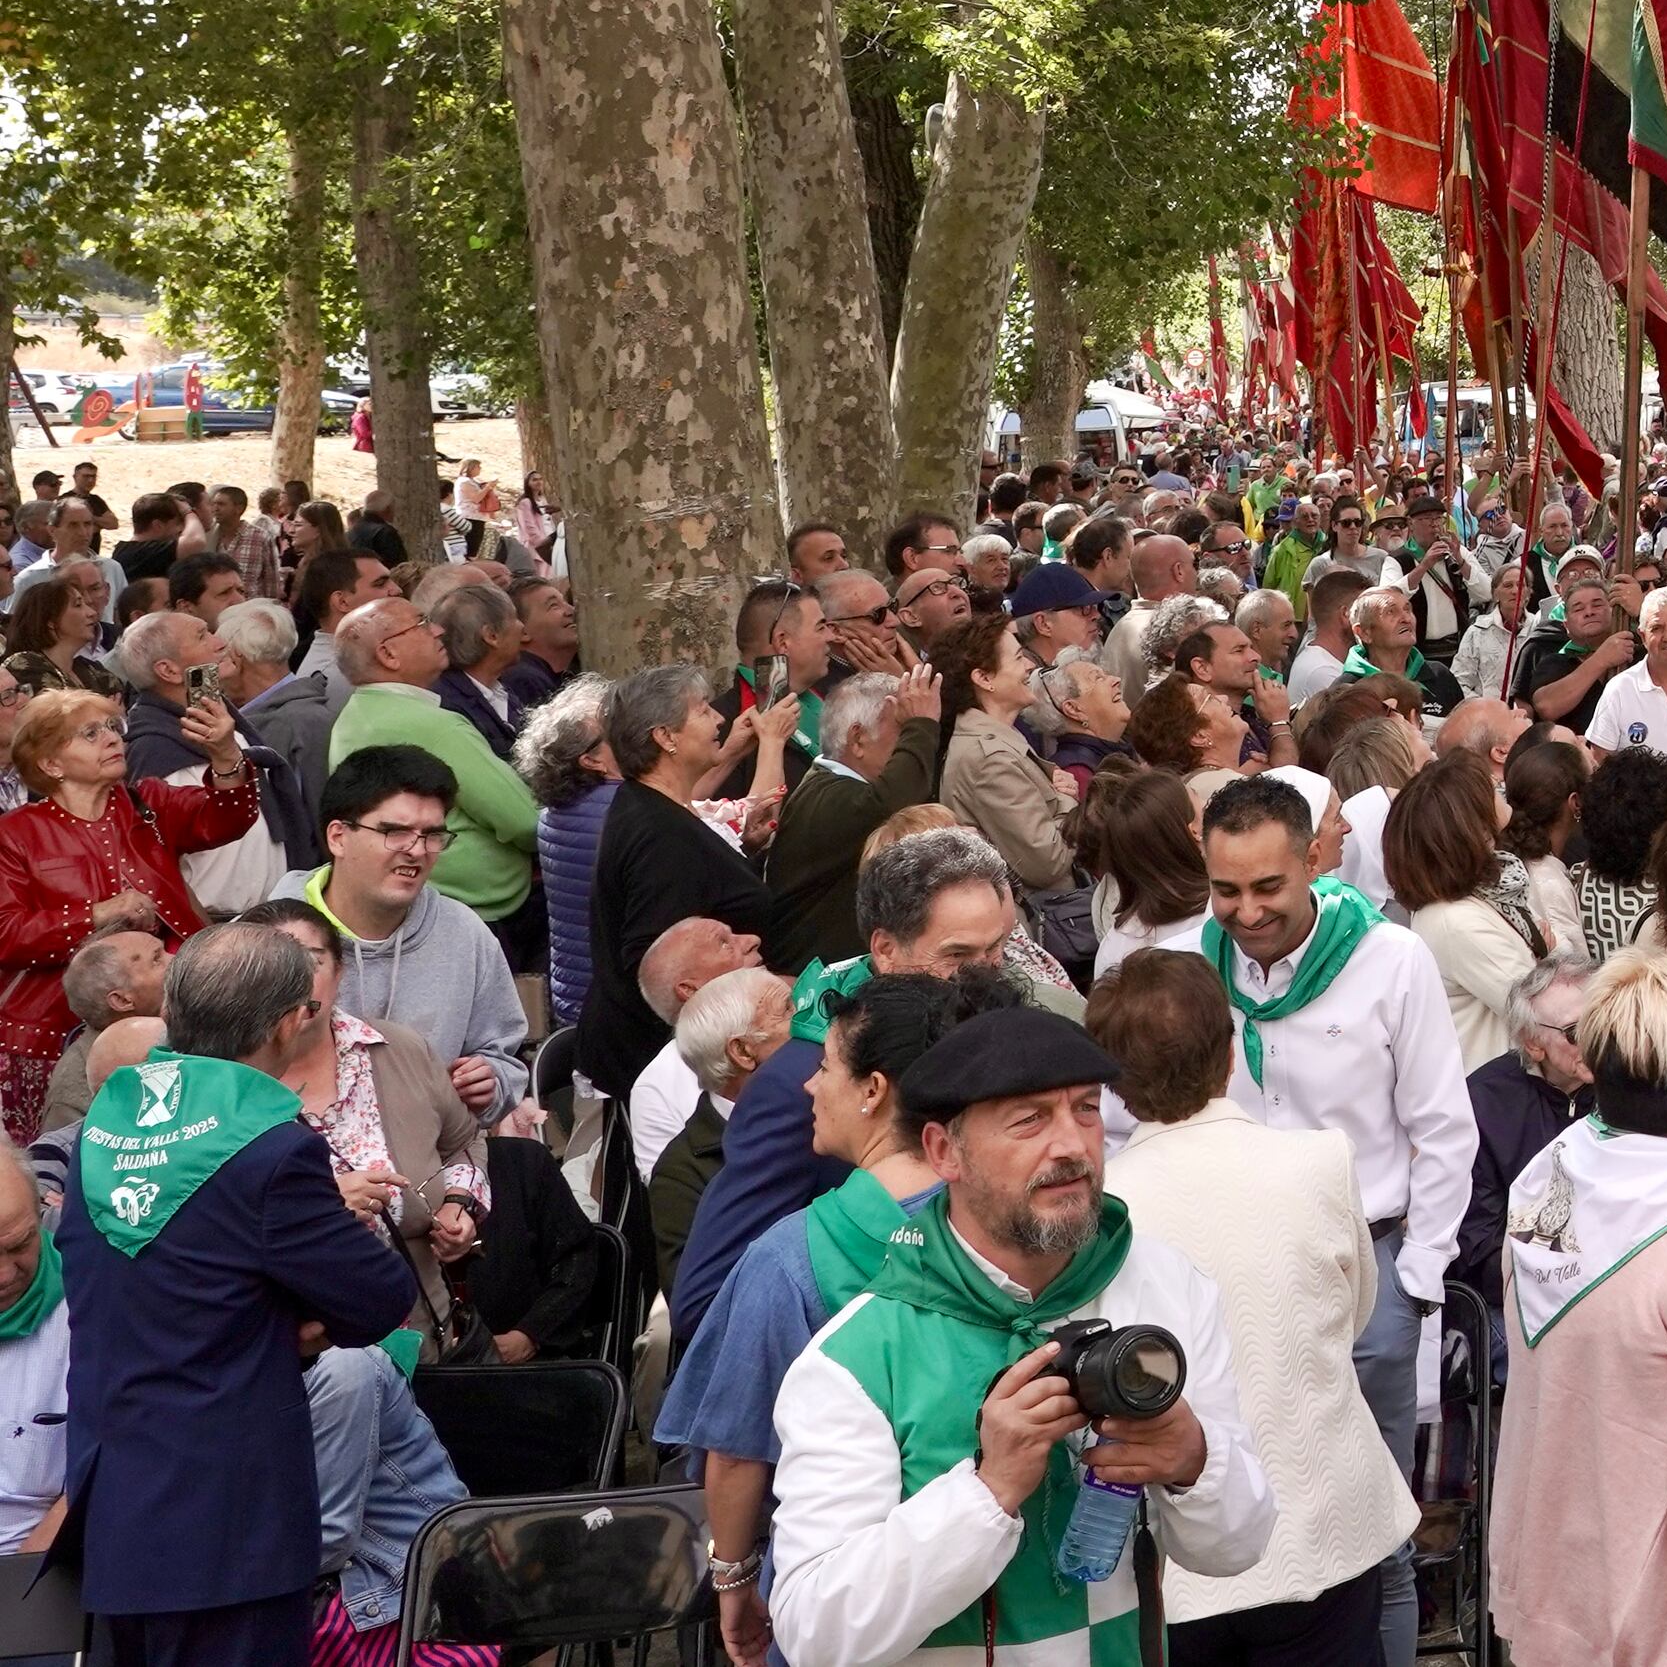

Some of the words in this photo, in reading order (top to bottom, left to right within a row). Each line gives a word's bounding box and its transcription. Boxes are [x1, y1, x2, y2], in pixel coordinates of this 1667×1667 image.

[83, 1126, 124, 1150] FIESTAS
[121, 1137, 142, 1150] DEL
[143, 1130, 180, 1150] VALLE
[181, 1115, 219, 1141] 2025
[113, 1150, 168, 1171] SALDAÑA
